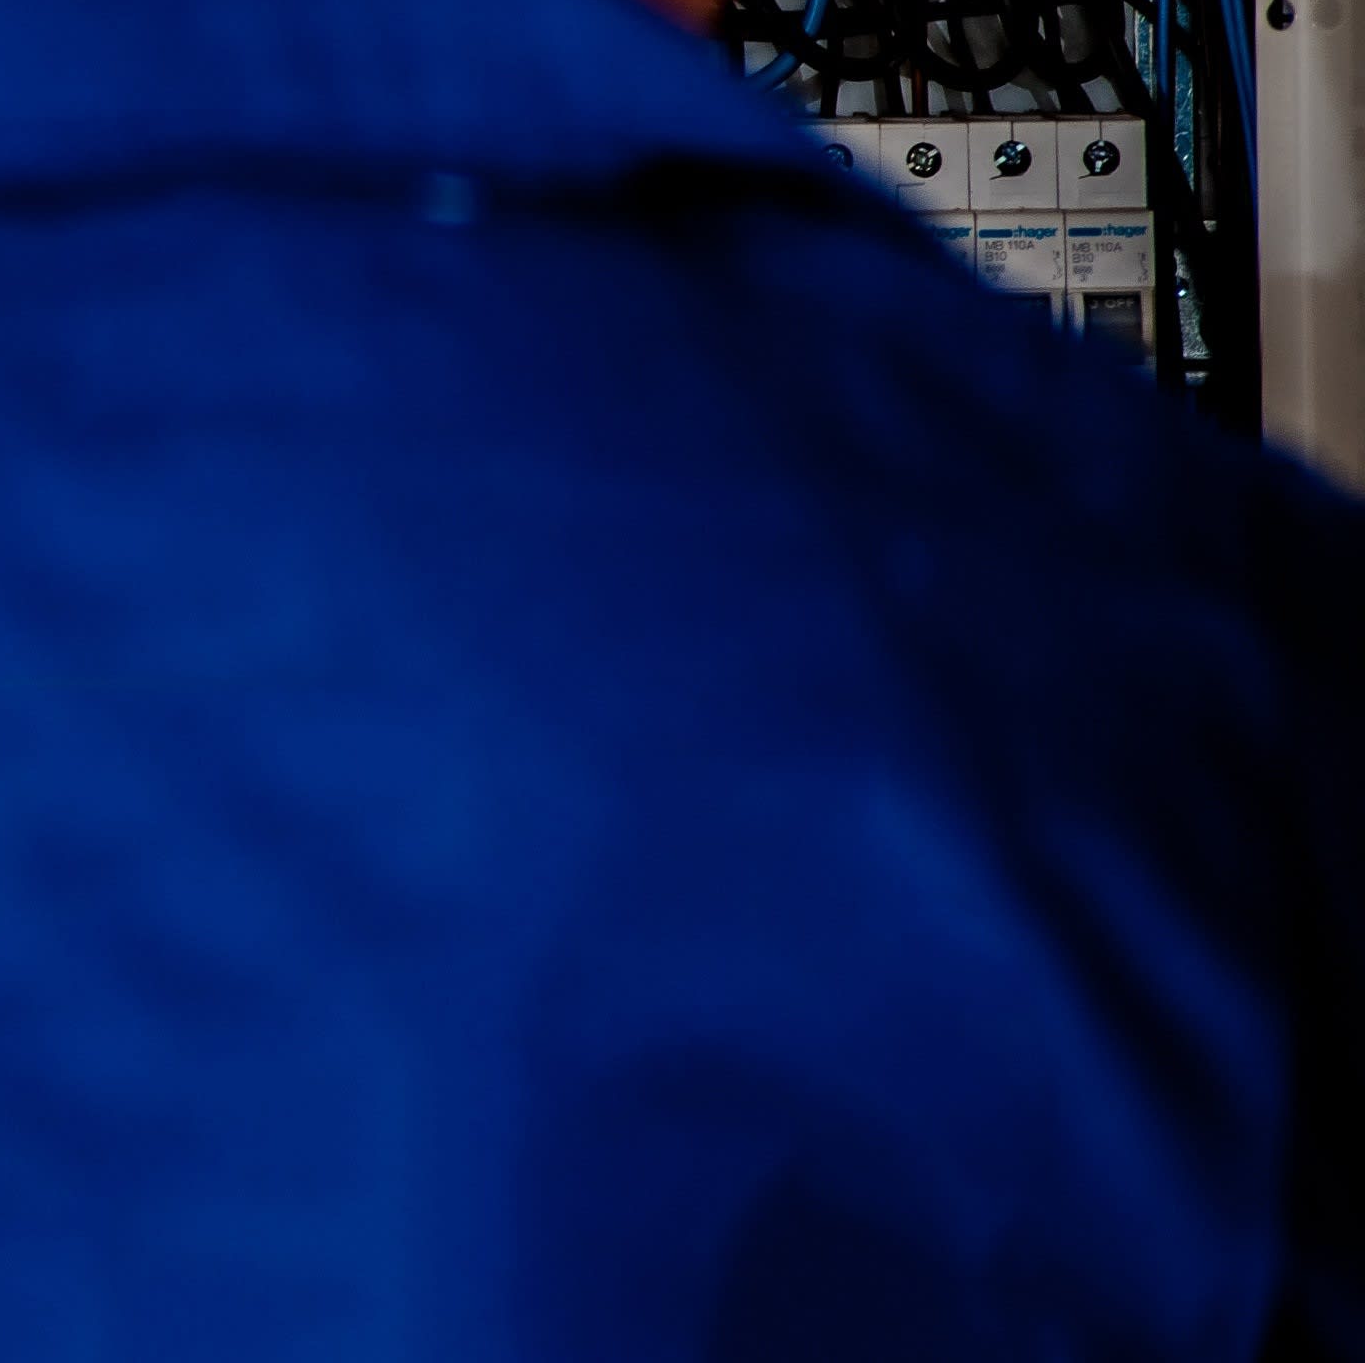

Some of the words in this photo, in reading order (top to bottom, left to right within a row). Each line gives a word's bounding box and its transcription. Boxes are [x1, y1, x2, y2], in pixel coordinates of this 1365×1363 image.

[1017, 225, 1058, 239] hager
[1106, 223, 1148, 238] hager
[1008, 240, 1035, 251] 110A
[1094, 242, 1123, 252] 110A
[1104, 299, 1135, 309] OFF
